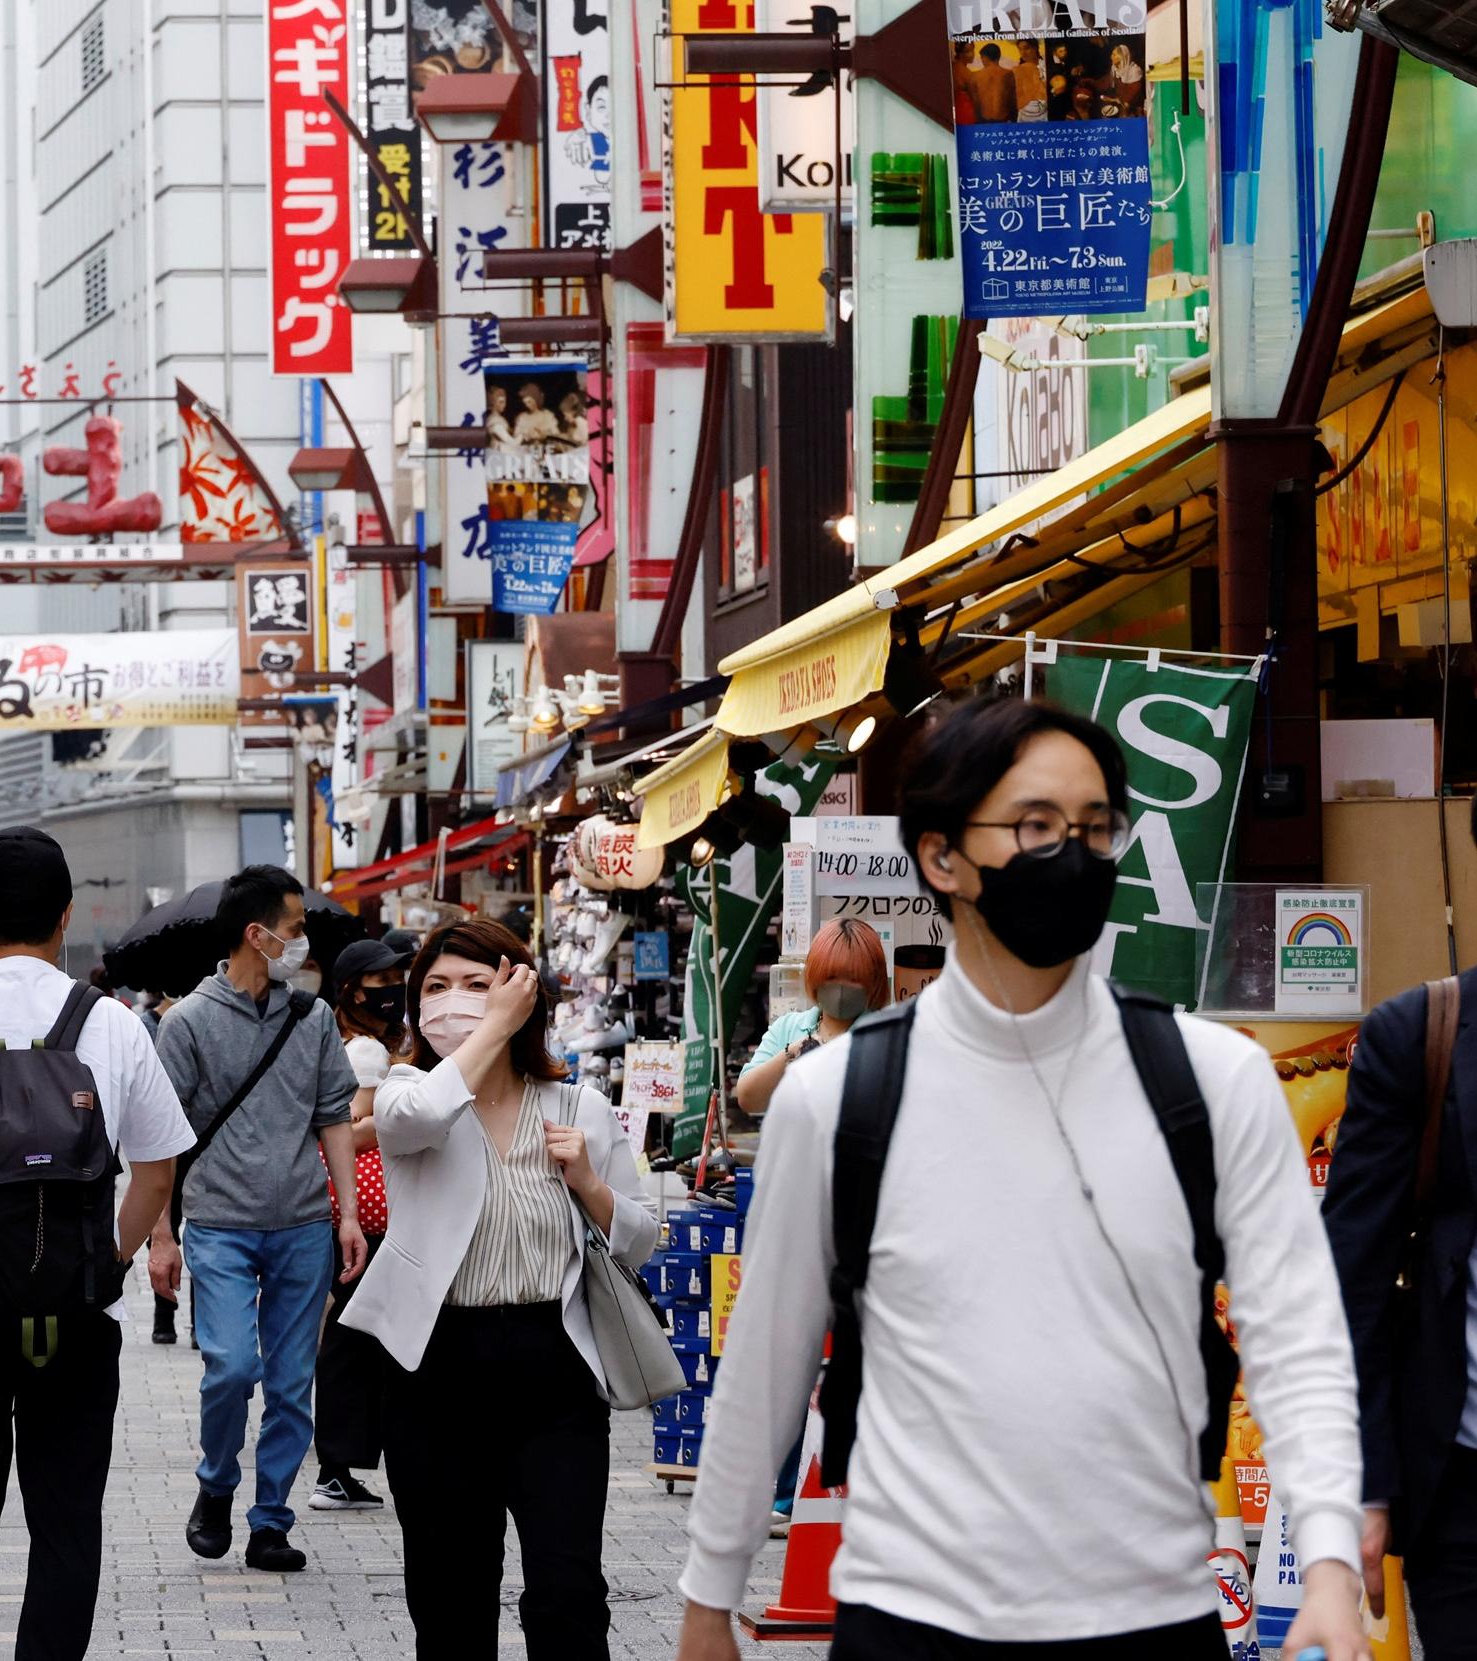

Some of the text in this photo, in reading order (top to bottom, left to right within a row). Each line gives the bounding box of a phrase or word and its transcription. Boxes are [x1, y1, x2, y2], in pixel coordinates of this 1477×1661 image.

[994, 32, 1015, 40] from
[1030, 29, 1064, 39] National
[1065, 28, 1100, 37] Galleries
[1100, 28, 1110, 36] of
[1000, 190, 1019, 199] THE
[985, 194, 1036, 210] GREATS
[960, 190, 1152, 235] 美の巨匠たち
[1014, 278, 1090, 292] 東京都美術館
[811, 655, 837, 704] SHOES
[612, 834, 635, 877] 炭火
[1287, 949, 1352, 957] 新型コロナウイルス
[1291, 958, 1348, 966] 感染拡大防止中
[1279, 1553, 1295, 1567] NO
